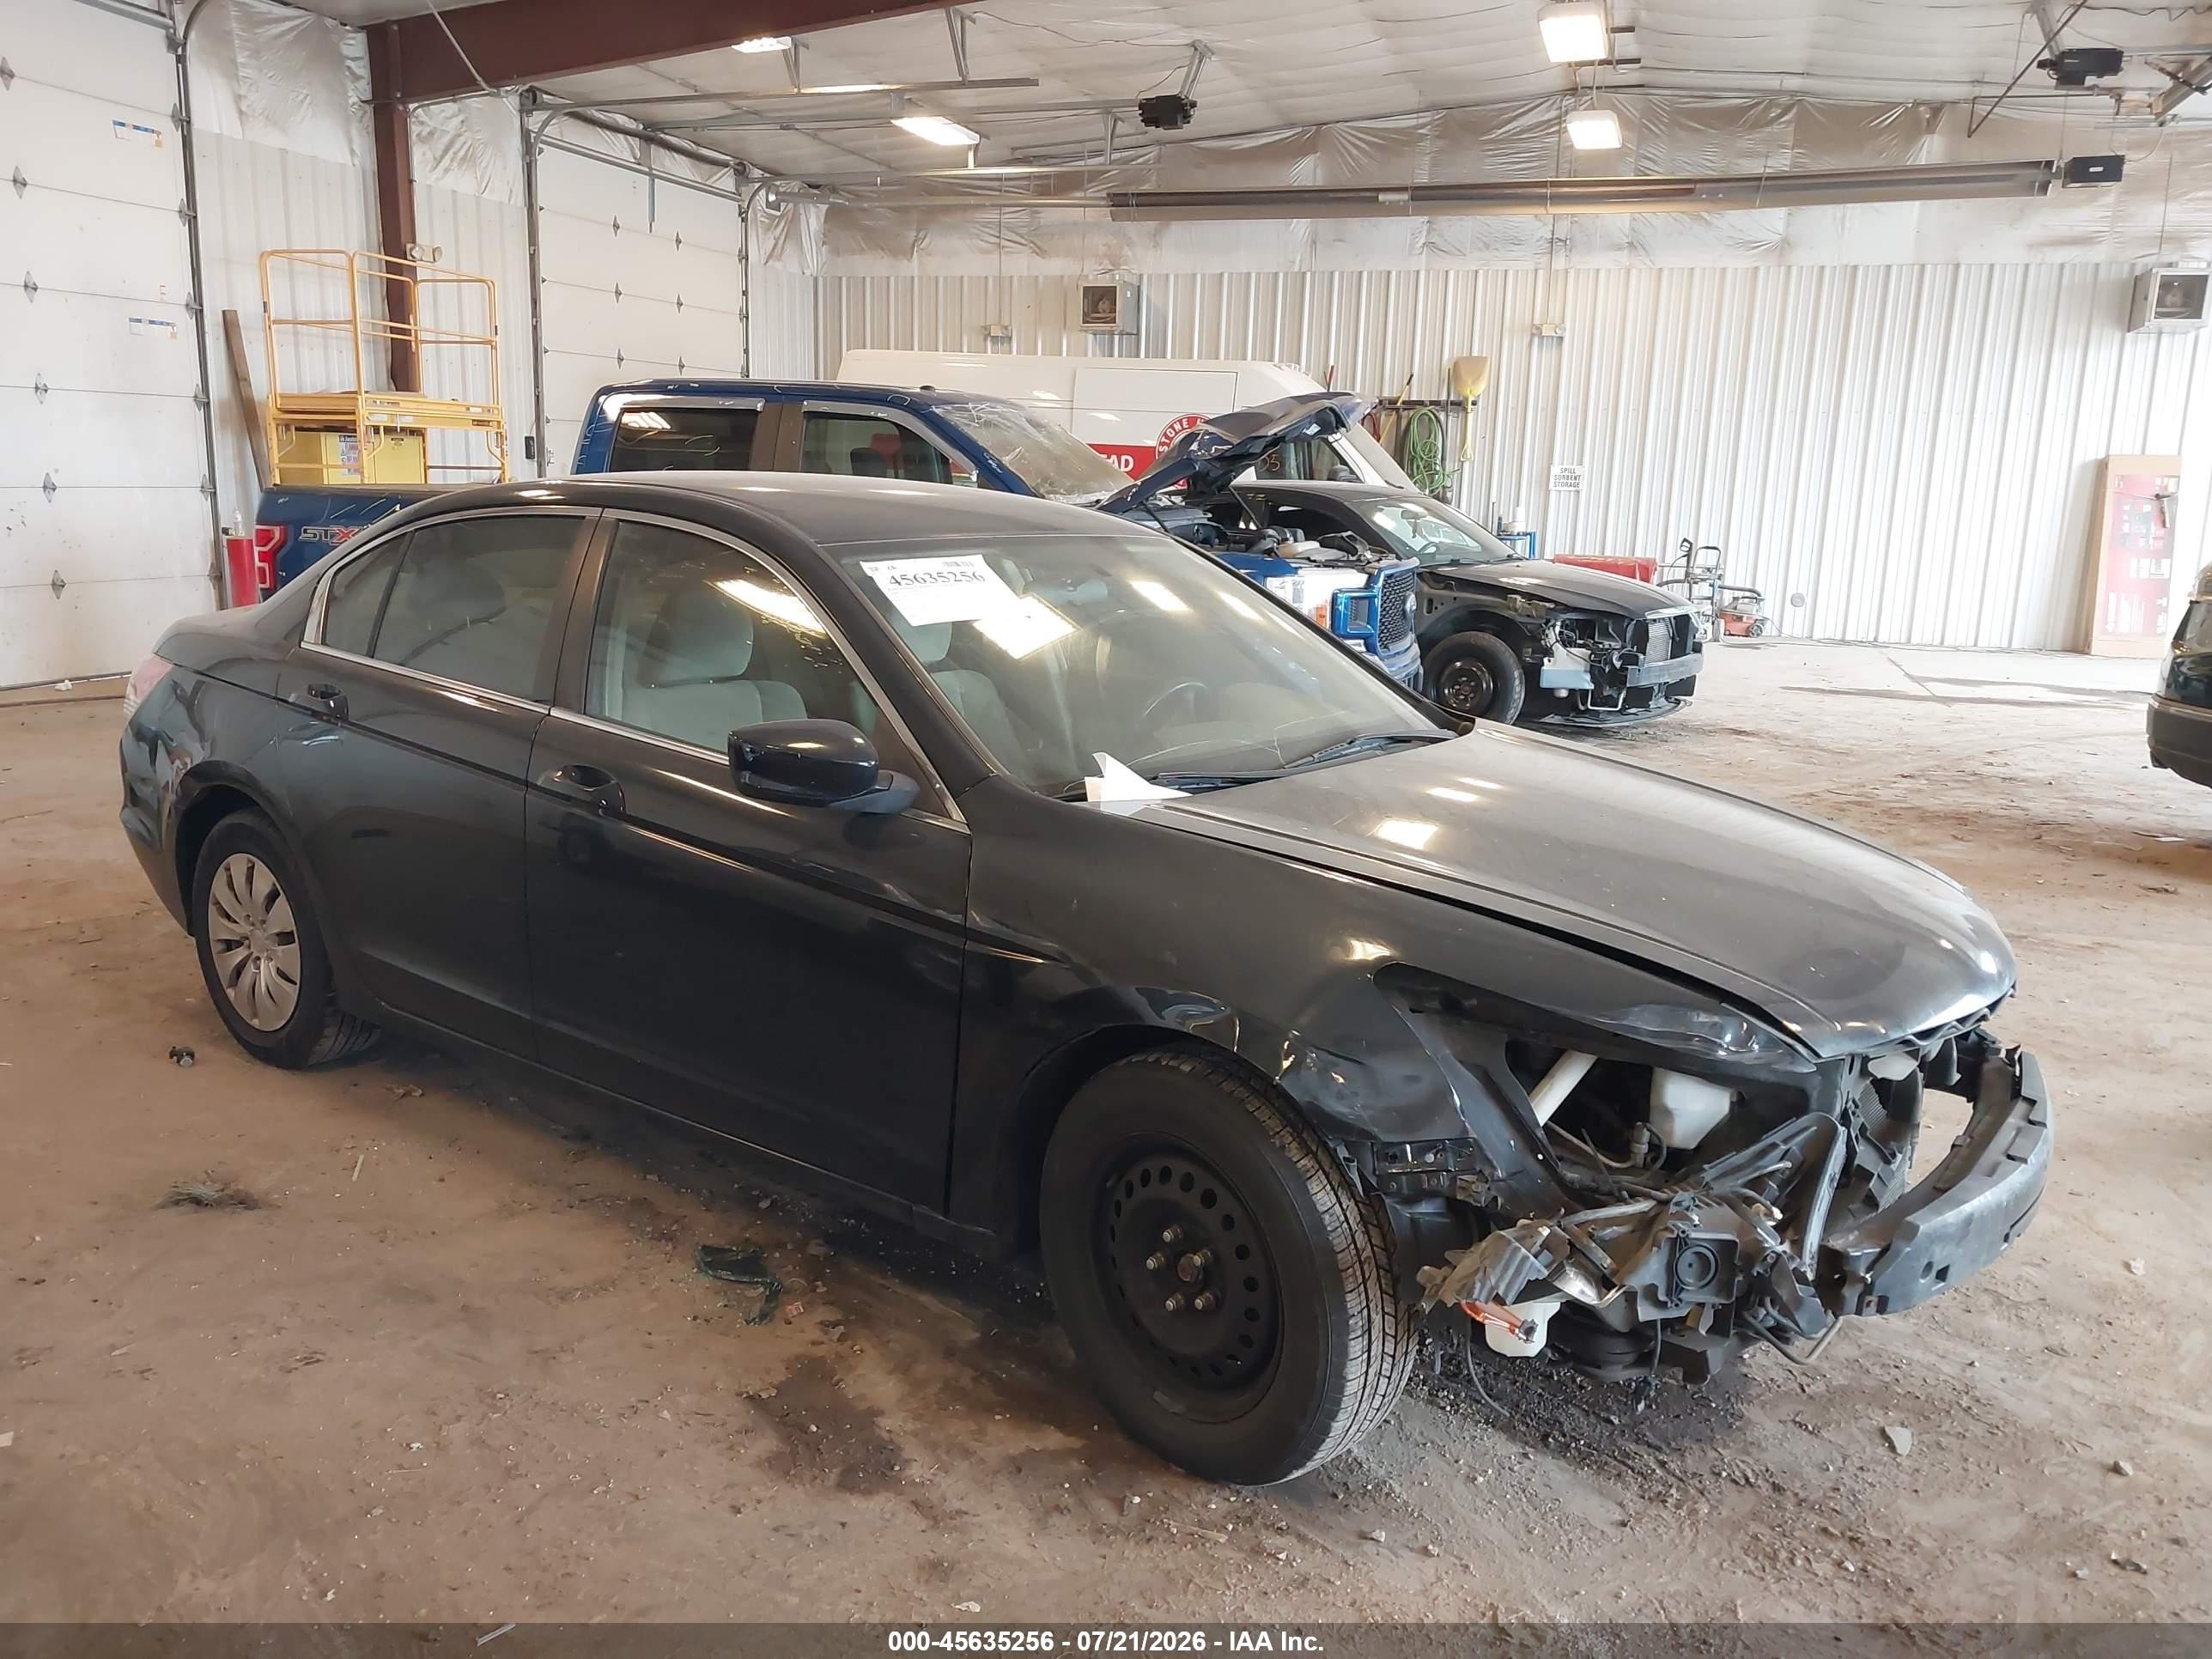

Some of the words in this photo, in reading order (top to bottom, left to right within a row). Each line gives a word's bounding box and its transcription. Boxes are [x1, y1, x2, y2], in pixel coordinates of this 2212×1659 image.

[1158, 417, 1189, 453] STONE
[298, 525, 360, 545] STX
[889, 570, 986, 586] 45635256
